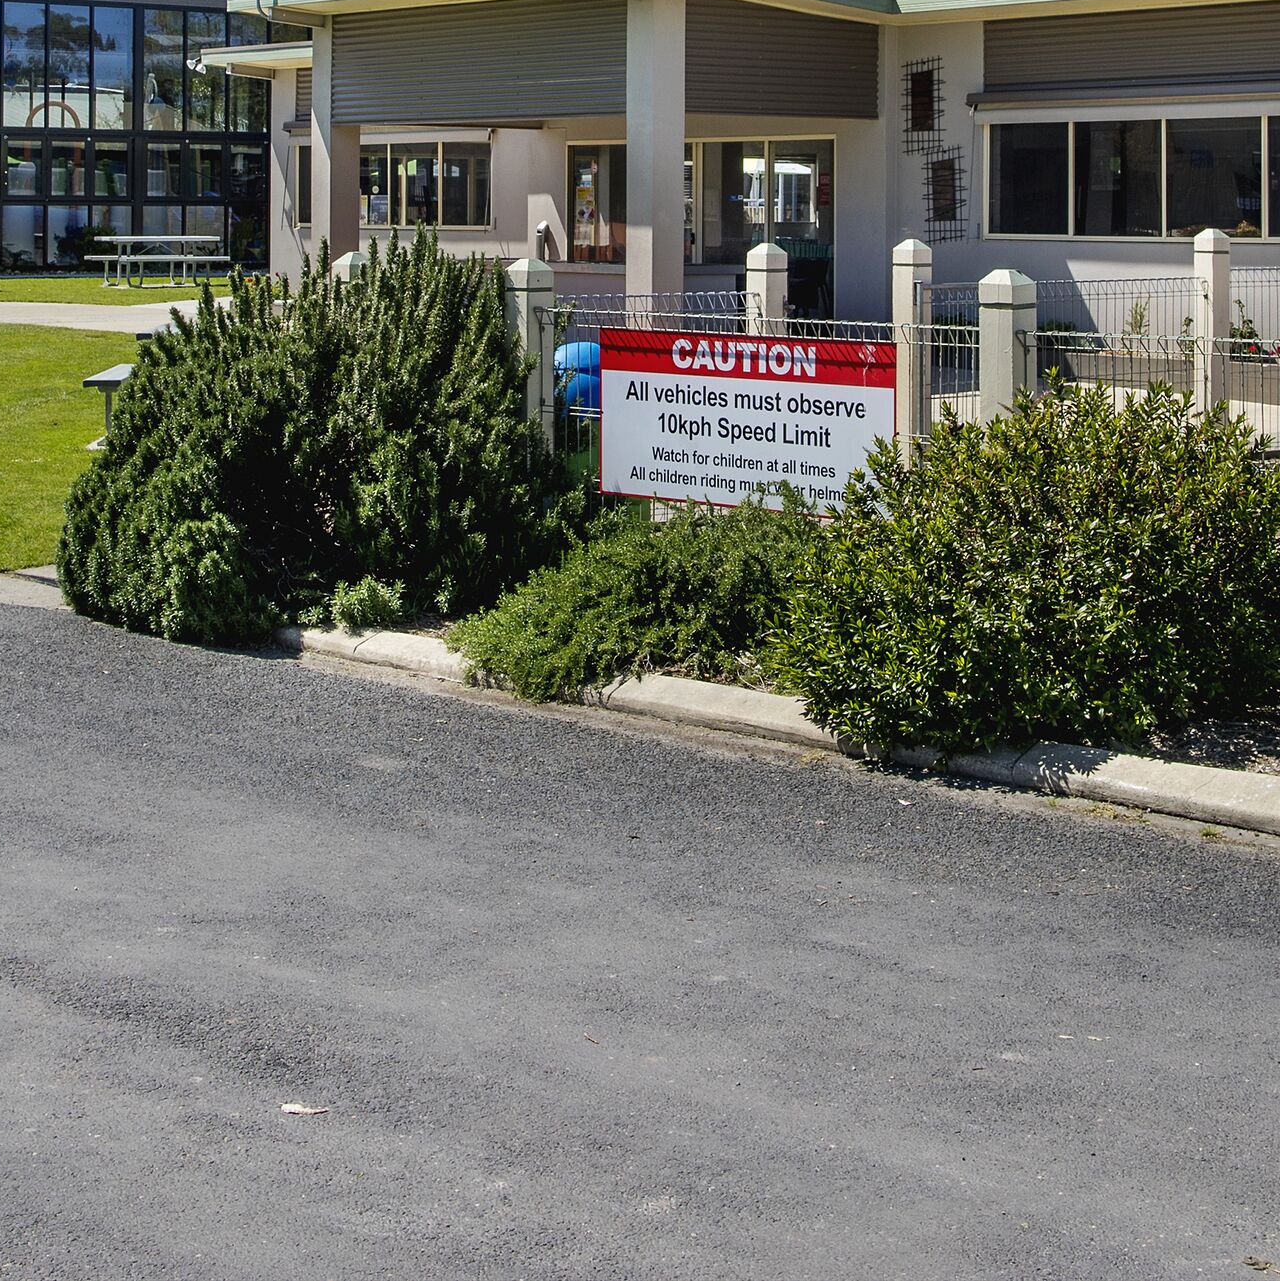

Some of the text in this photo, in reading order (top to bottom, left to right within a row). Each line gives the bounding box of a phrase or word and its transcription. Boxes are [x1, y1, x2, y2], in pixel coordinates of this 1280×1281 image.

[672, 338, 816, 377] CAUTION
[626, 380, 866, 419] All vehicles must observe
[658, 412, 831, 448] 10kph Speed Limit
[652, 446, 836, 478] Watch for children at all times
[630, 466, 646, 480] All
[649, 469, 697, 486] children
[701, 473, 736, 493] riding
[775, 483, 806, 497] war
[809, 484, 849, 502] helme
